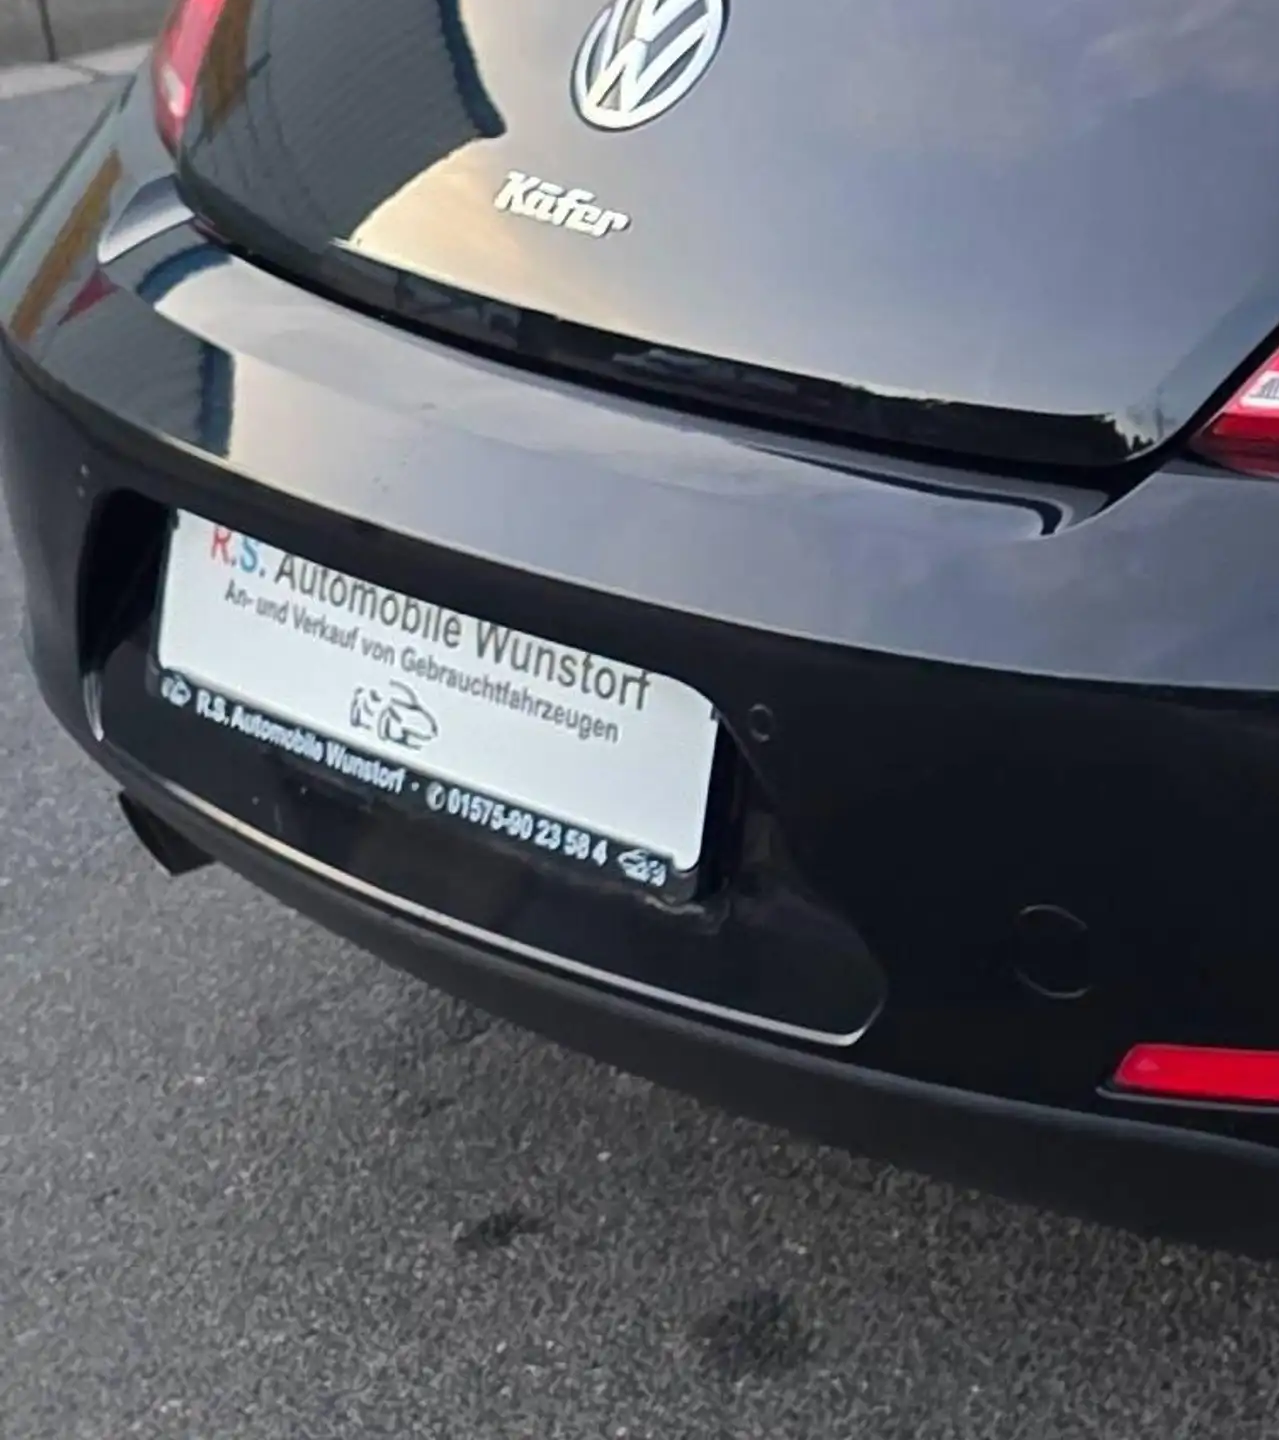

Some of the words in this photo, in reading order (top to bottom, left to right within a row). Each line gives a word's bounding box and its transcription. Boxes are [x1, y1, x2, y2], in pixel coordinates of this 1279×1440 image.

[494, 169, 632, 237] Käfer
[210, 525, 267, 578] R.S.
[273, 552, 463, 650] Automobile
[475, 616, 652, 711] Wunstorf
[224, 578, 256, 609] An-
[255, 595, 289, 625] und
[292, 603, 360, 651] Verkauf
[361, 636, 396, 666] von
[399, 646, 620, 744] Gebrauchtfahrzeugen
[231, 705, 325, 763] Automobile
[325, 740, 406, 795] Wunstorf
[534, 818, 562, 851] 23
[591, 839, 609, 868] 4
